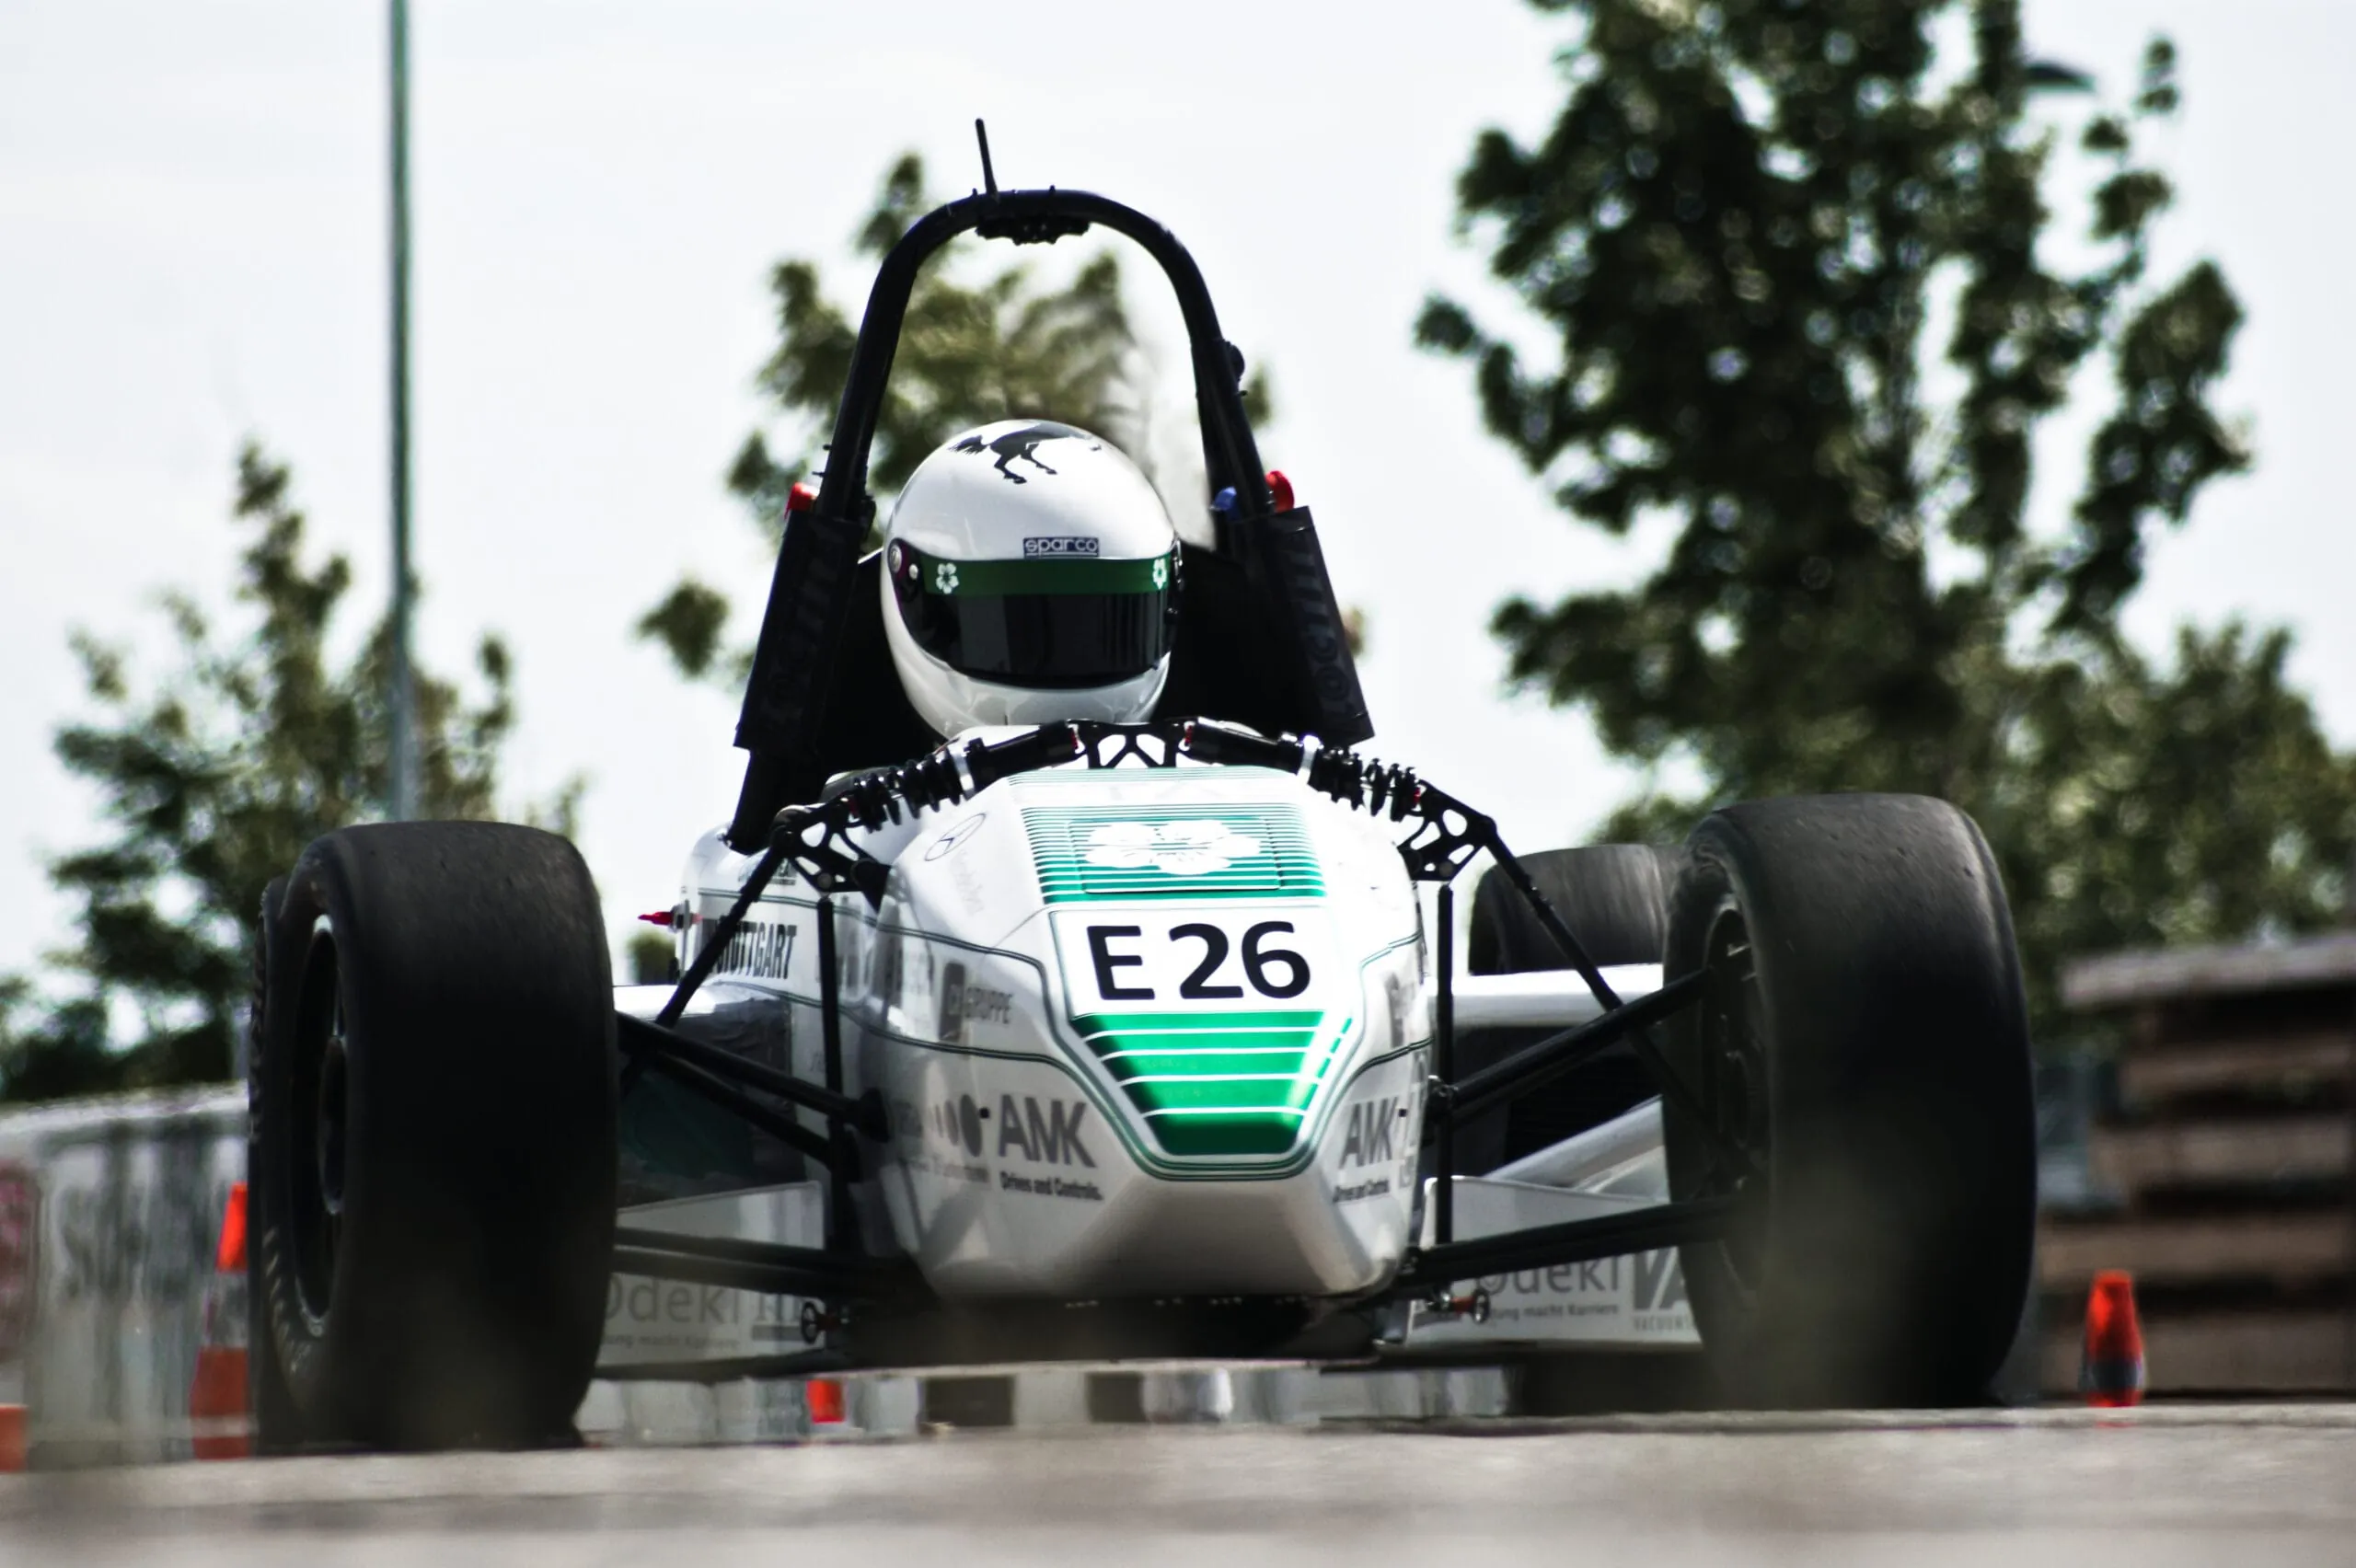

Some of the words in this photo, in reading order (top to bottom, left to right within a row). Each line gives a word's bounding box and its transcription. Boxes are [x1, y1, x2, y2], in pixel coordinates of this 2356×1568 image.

[1025, 539, 1098, 556] sparco
[999, 1094, 1097, 1168] AMK
[1338, 1097, 1398, 1169] AMK
